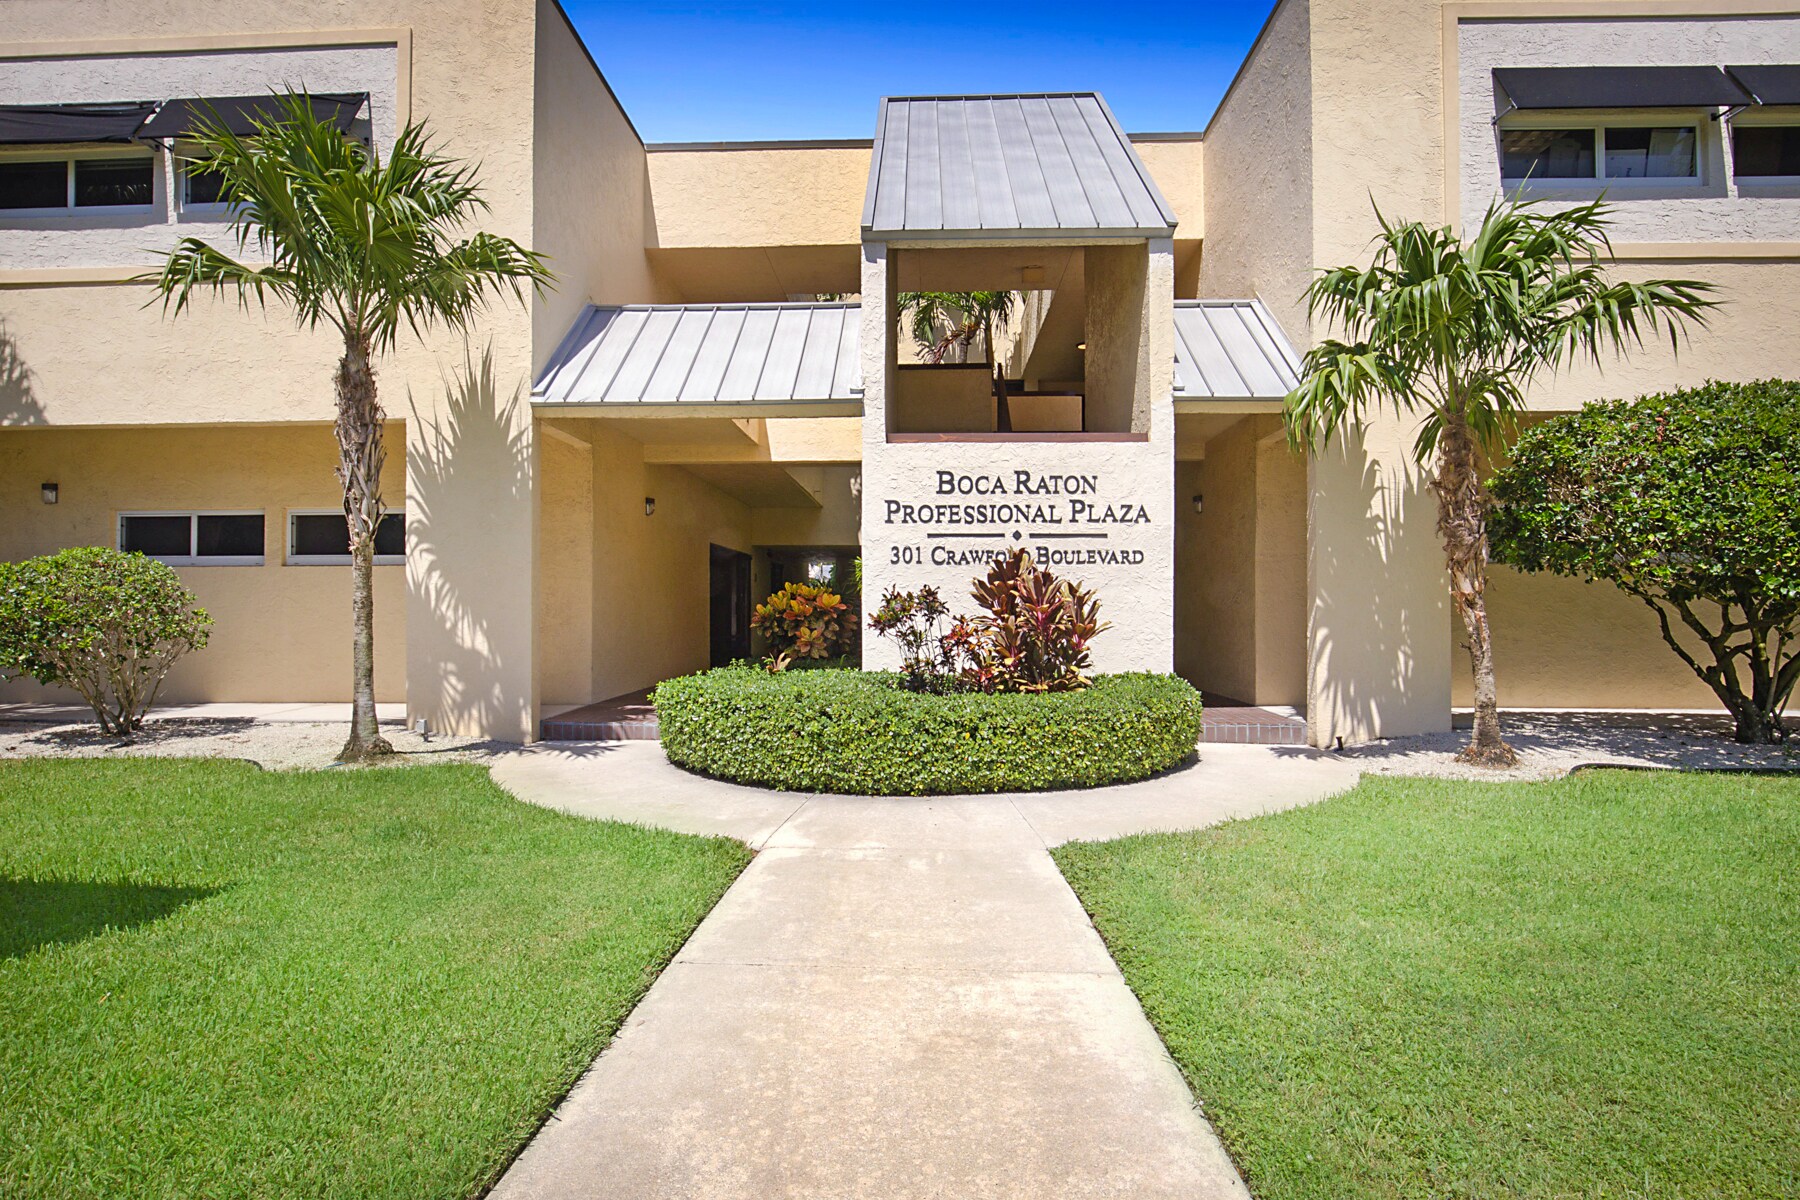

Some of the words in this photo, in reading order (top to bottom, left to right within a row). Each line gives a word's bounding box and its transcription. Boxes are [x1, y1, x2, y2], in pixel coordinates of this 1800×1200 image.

[935, 470, 1008, 495] BOCA
[1013, 470, 1098, 495] RATON
[884, 499, 1063, 525] PROFESSIONAL
[1068, 499, 1151, 524] PLAZA
[890, 546, 923, 565] 301
[931, 546, 1032, 566] CRAWFO
[1035, 546, 1145, 565] BOULEVARD
